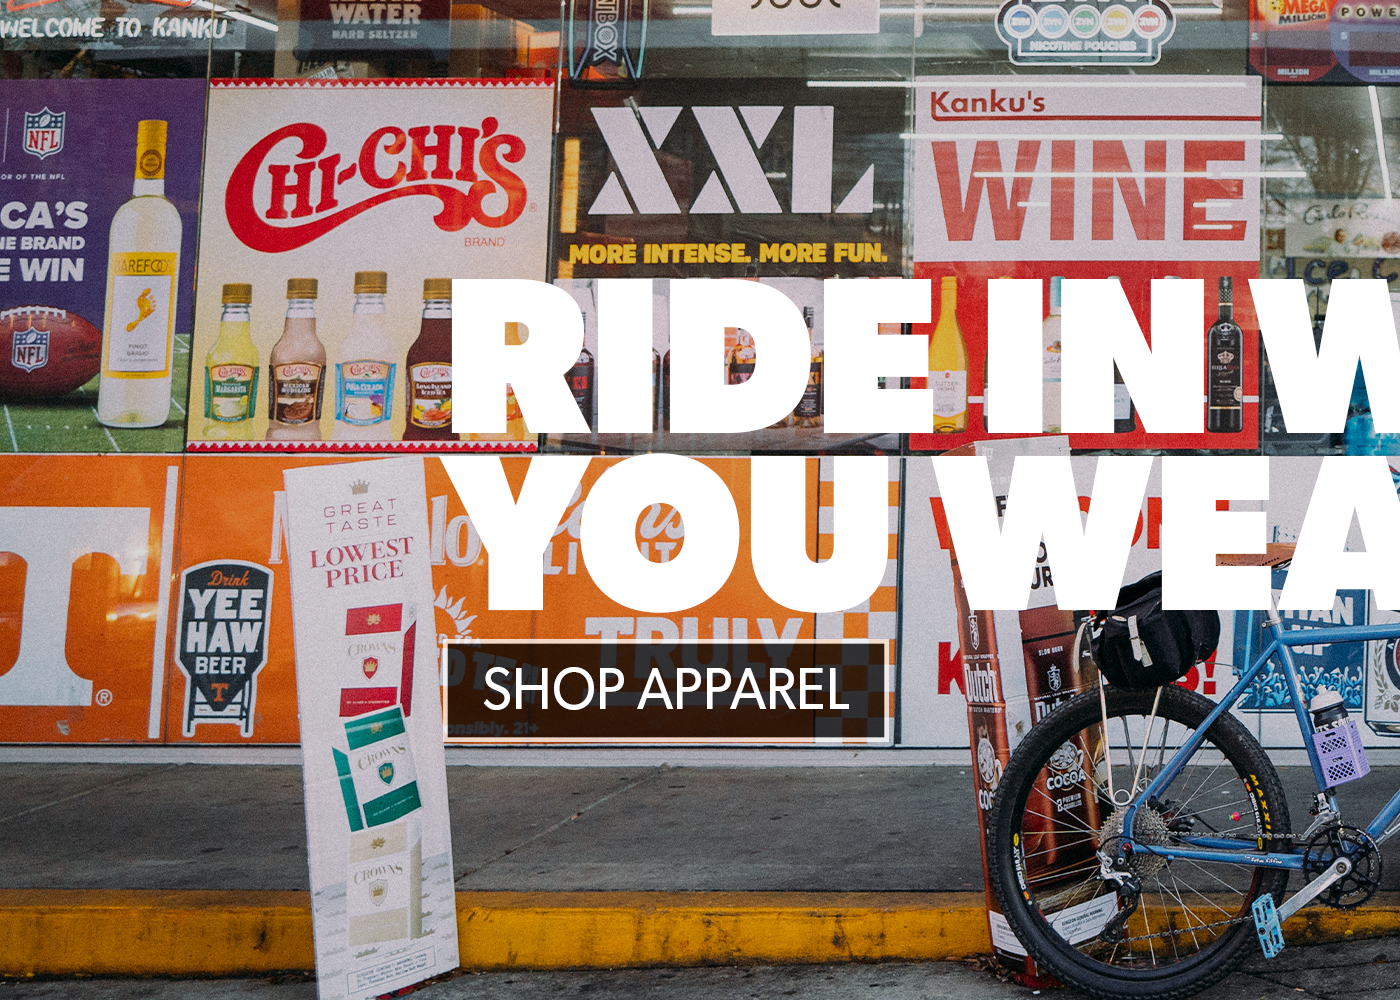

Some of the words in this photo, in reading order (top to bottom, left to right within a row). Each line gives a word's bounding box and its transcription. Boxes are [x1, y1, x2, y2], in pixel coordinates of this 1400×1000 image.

[330, 2, 422, 25] WATER
[1283, 0, 1326, 14] MEGA
[0, 17, 105, 38] WELCOME
[116, 17, 141, 37] TO
[152, 17, 228, 38] KANKU
[1011, 17, 1031, 26] ZYN
[1278, 13, 1326, 25] MILLIONS
[332, 30, 364, 39] HARD
[370, 30, 418, 39] SELTZER
[1030, 41, 1082, 51] NICOTINE
[1085, 41, 1137, 51] POUCHES
[1277, 68, 1309, 76] MILLION
[931, 90, 1046, 113] Kanku's
[28, 130, 59, 151] NFL
[587, 105, 875, 215] XXL
[931, 140, 1248, 242] WINE
[21, 236, 86, 250] BRAND
[464, 237, 506, 247] BRAND
[569, 243, 638, 264] MORE
[643, 243, 752, 264] INTENSE.
[759, 243, 827, 264] MORE
[833, 243, 888, 264] FUN.
[20, 258, 85, 282] WIN
[17, 346, 43, 364] NFL
[323, 498, 397, 518] GREAT
[326, 514, 397, 532] TASTE
[310, 536, 414, 569] LOWEST
[207, 569, 250, 588] Drink
[325, 561, 404, 588] PRICE
[188, 589, 263, 620] YEE
[186, 622, 262, 655] HAW
[347, 642, 396, 657] CROWNS
[195, 657, 246, 676] BEER
[964, 663, 1000, 703] Dutch
[357, 745, 406, 771] CROWNS
[1046, 769, 1086, 790] COCOA
[353, 864, 404, 884] CROWNS
